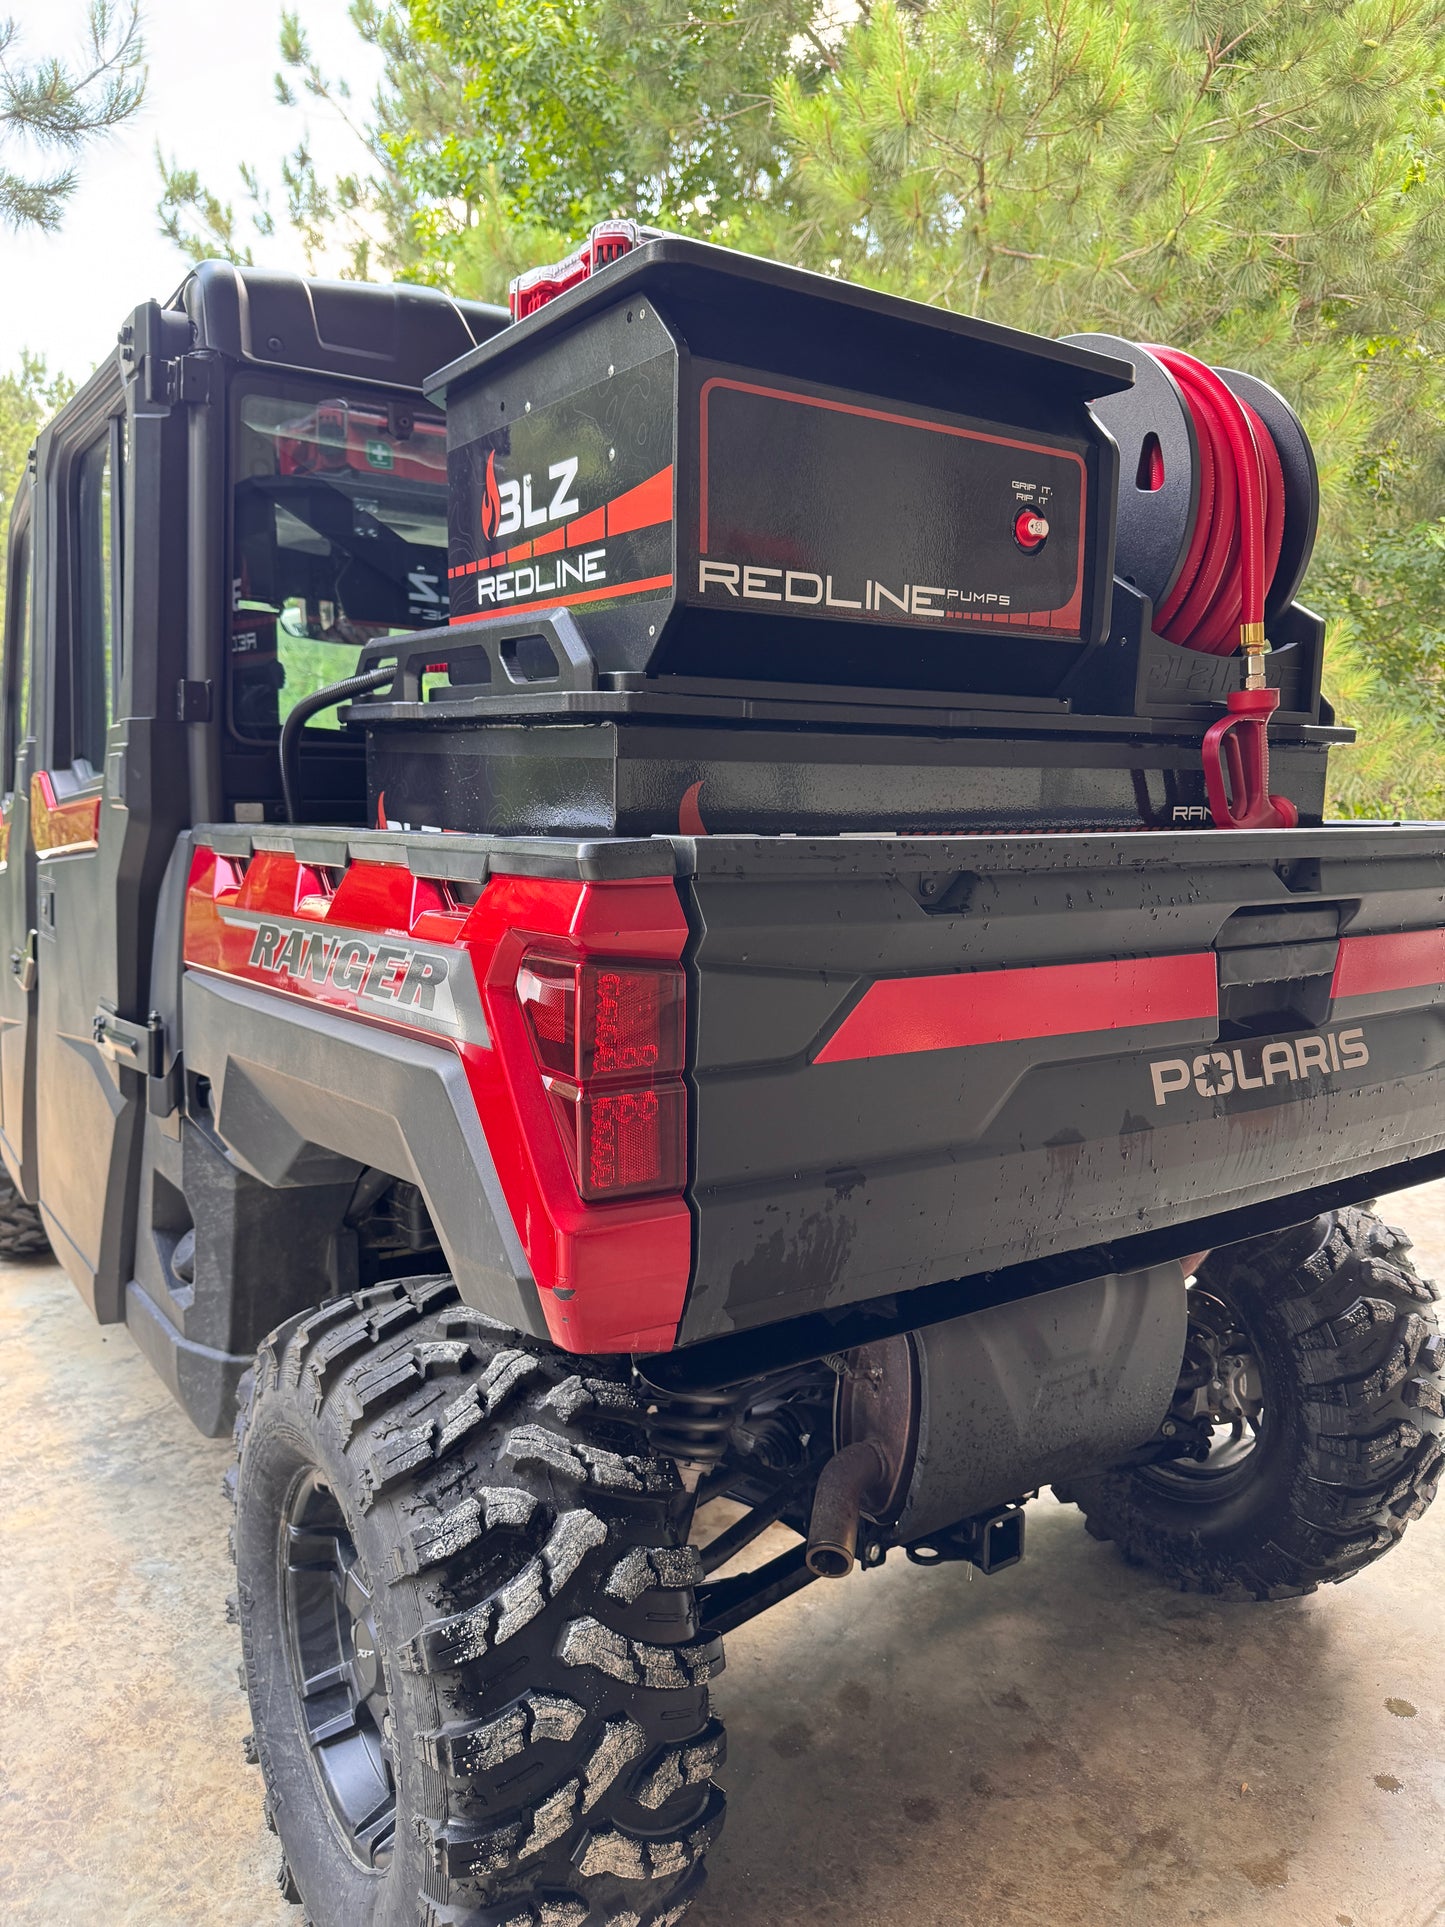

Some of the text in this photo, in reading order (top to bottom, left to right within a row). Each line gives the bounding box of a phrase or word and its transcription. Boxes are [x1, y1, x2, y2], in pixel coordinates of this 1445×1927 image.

[493, 456, 580, 538] BLZ
[1011, 480, 1053, 496] GRIP IT,
[1015, 492, 1049, 505] RIP IT
[477, 548, 607, 606] REDLINE
[698, 559, 1011, 618] REDLINE PUMPS
[248, 922, 450, 1012] RANGER
[1149, 1027, 1370, 1107] POLARIS
